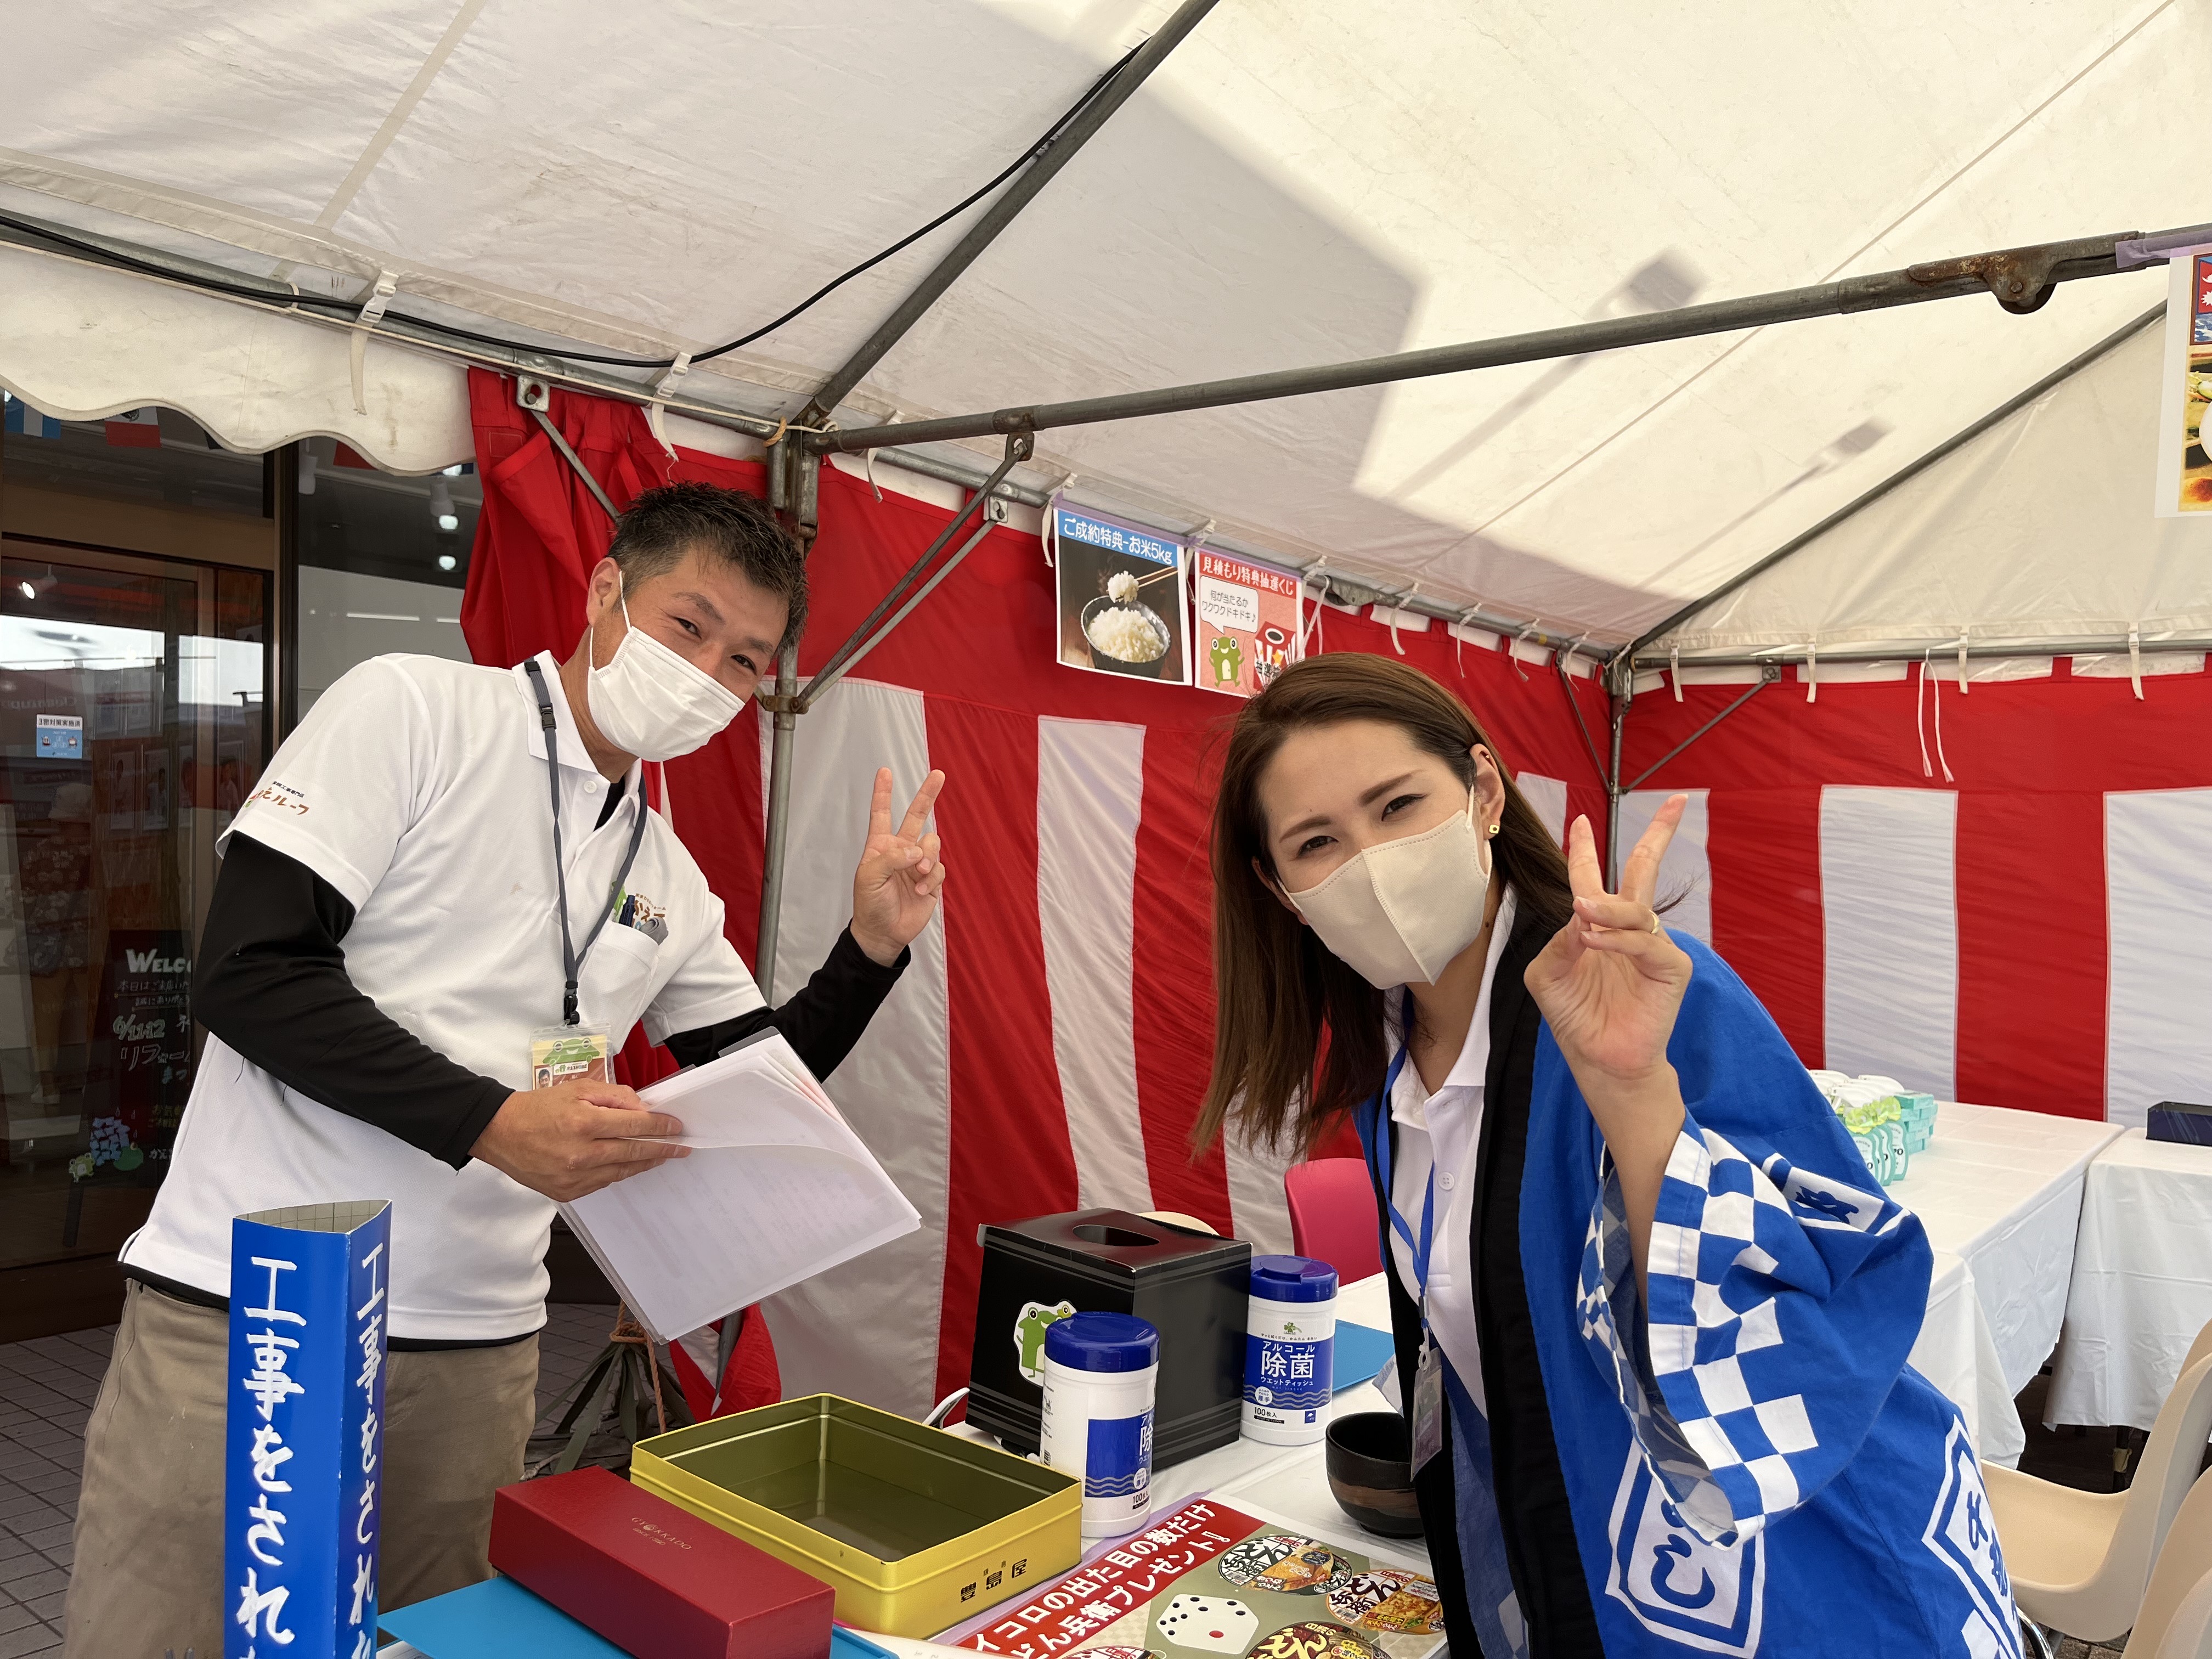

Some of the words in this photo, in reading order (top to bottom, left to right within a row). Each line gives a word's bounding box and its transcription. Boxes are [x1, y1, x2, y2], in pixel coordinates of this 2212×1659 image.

[1064, 518, 1172, 565] ご成約特典-お米5kg
[1203, 556, 1294, 596] 見積もり特典抽選くじ
[1210, 589, 1249, 608] 何が当たるか
[1263, 1340, 1316, 1353] アルコール
[1261, 1350, 1315, 1379] 除菌
[1260, 1376, 1313, 1386] ウエットティッシュ
[1254, 1407, 1278, 1418] 100枚入
[236, 1256, 307, 1659] 工事をされ
[975, 1501, 1216, 1652] イコロの出た目の数だけ
